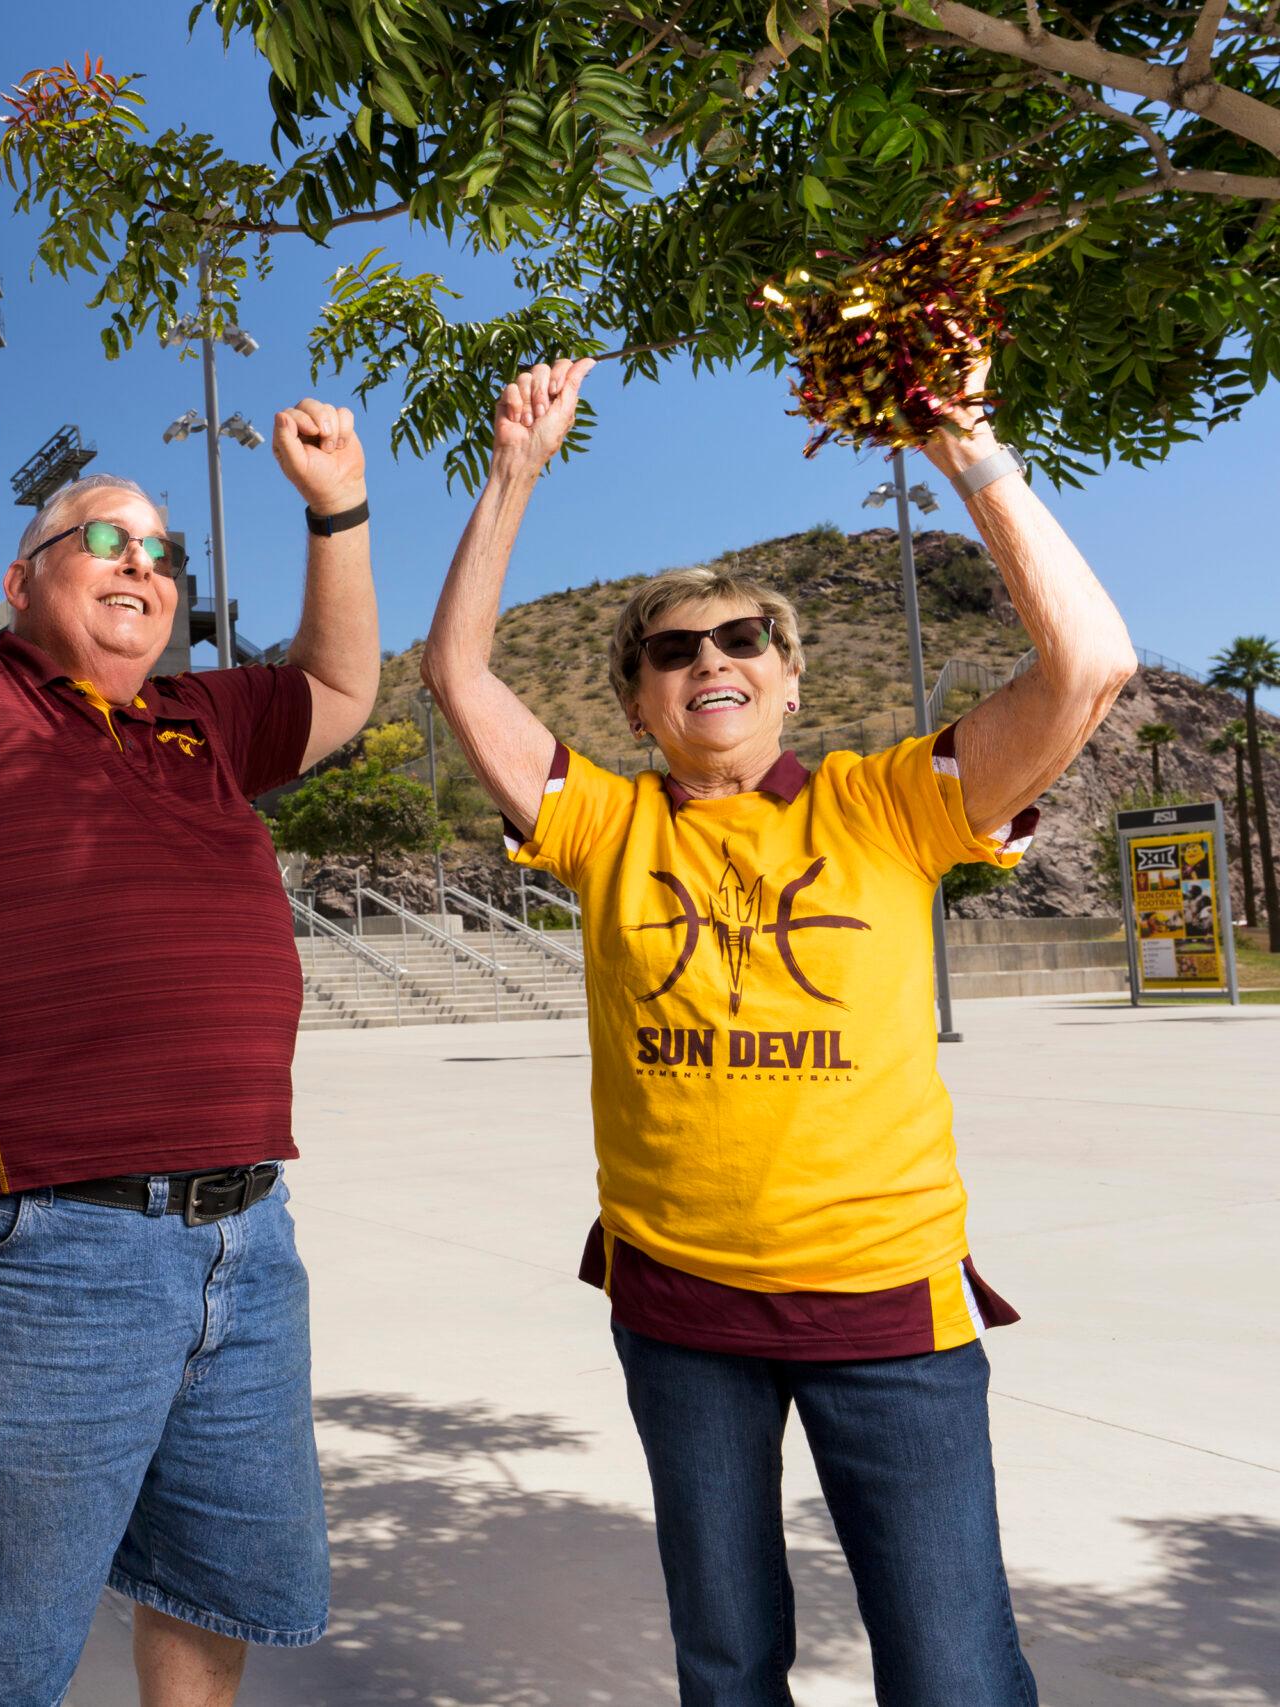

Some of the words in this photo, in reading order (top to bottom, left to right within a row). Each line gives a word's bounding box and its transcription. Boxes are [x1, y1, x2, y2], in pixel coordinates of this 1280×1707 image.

[1153, 810, 1178, 824] ASU
[637, 1026, 715, 1067] SUN
[636, 1068, 712, 1079] WOMEN'S
[726, 1073, 853, 1082] BASKETBALL
